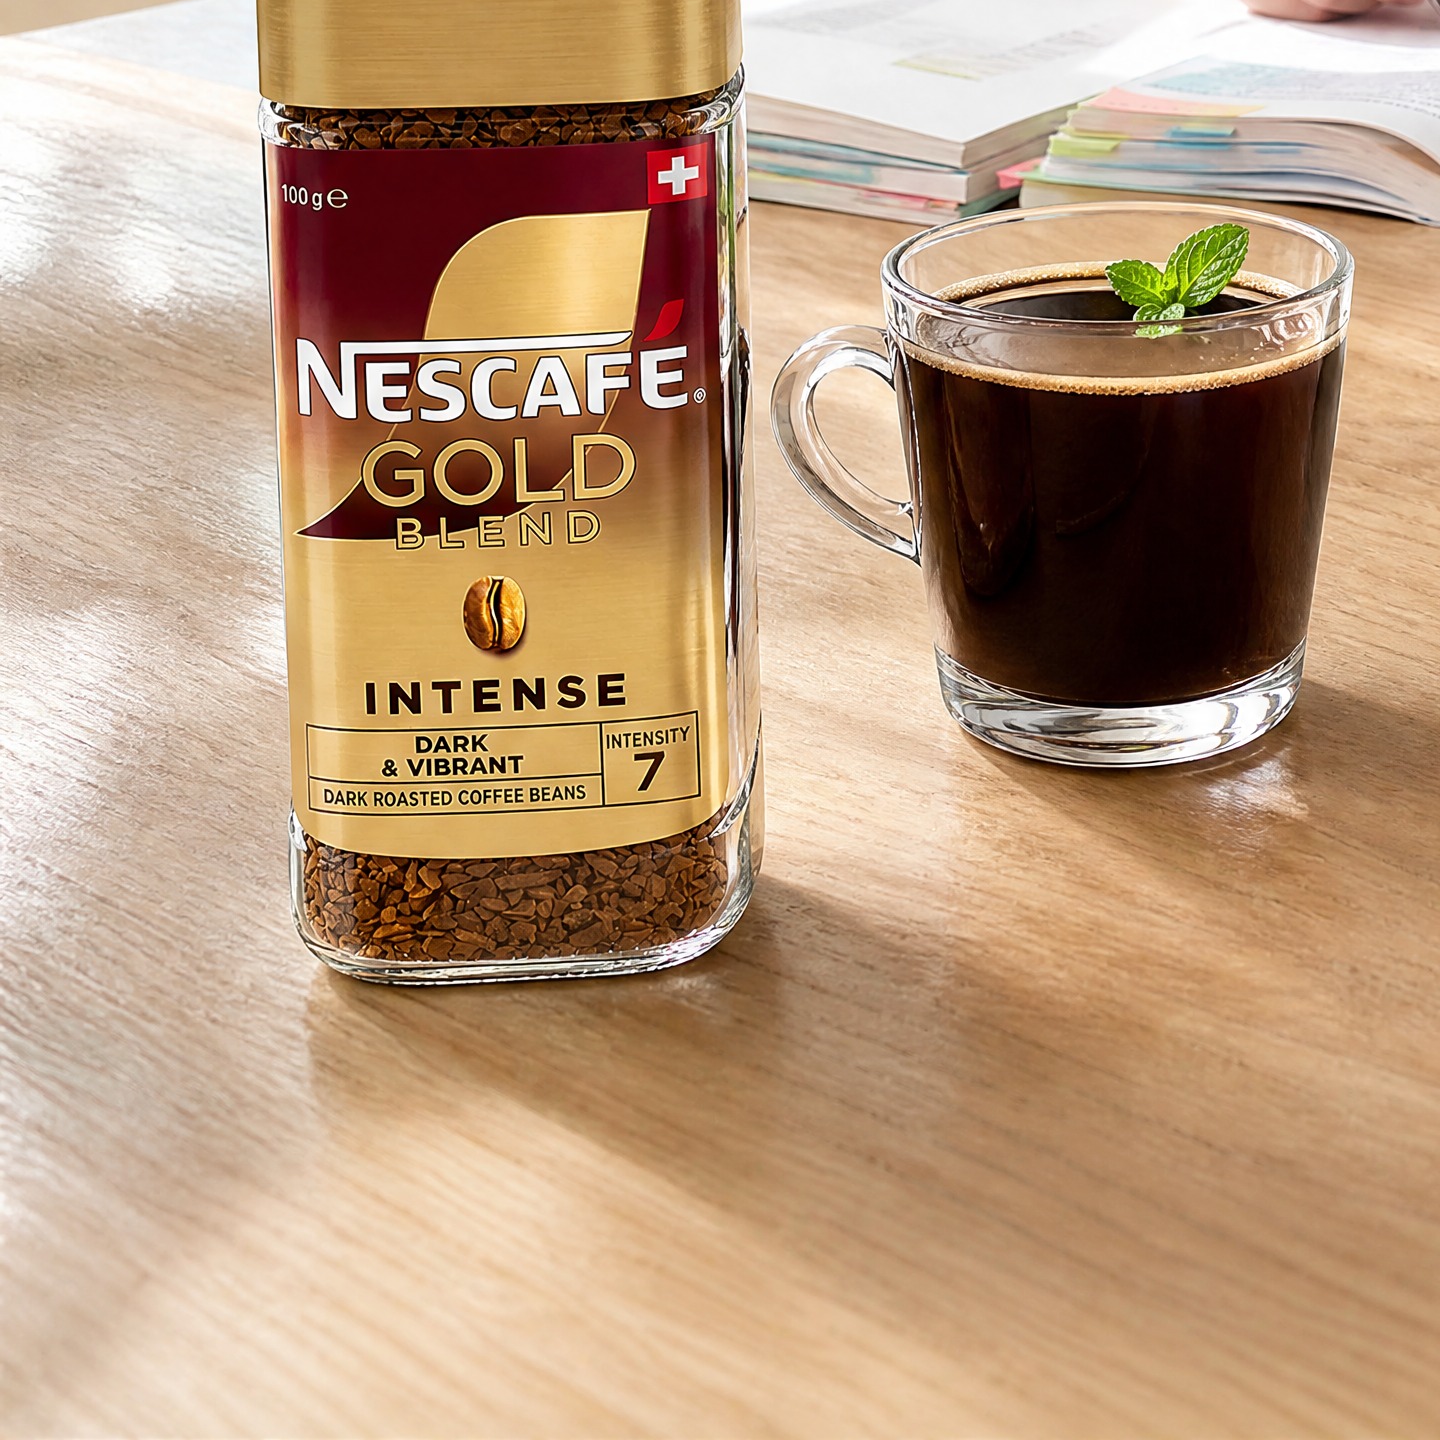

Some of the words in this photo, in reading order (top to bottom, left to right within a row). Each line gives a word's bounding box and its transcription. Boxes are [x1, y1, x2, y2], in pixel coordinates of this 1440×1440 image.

[360, 432, 637, 508] GOLD
[395, 510, 602, 550] BLEND
[364, 673, 628, 716] INTENSE
[415, 733, 489, 754] DARK
[606, 725, 691, 750] INTENSITY
[382, 759, 398, 777] &
[408, 755, 524, 777] VIBRANT
[633, 750, 666, 792] 7
[323, 789, 368, 807] DARK
[373, 786, 453, 807] ROASTED
[458, 785, 524, 805] COFFEE
[529, 784, 587, 803] BEANS
